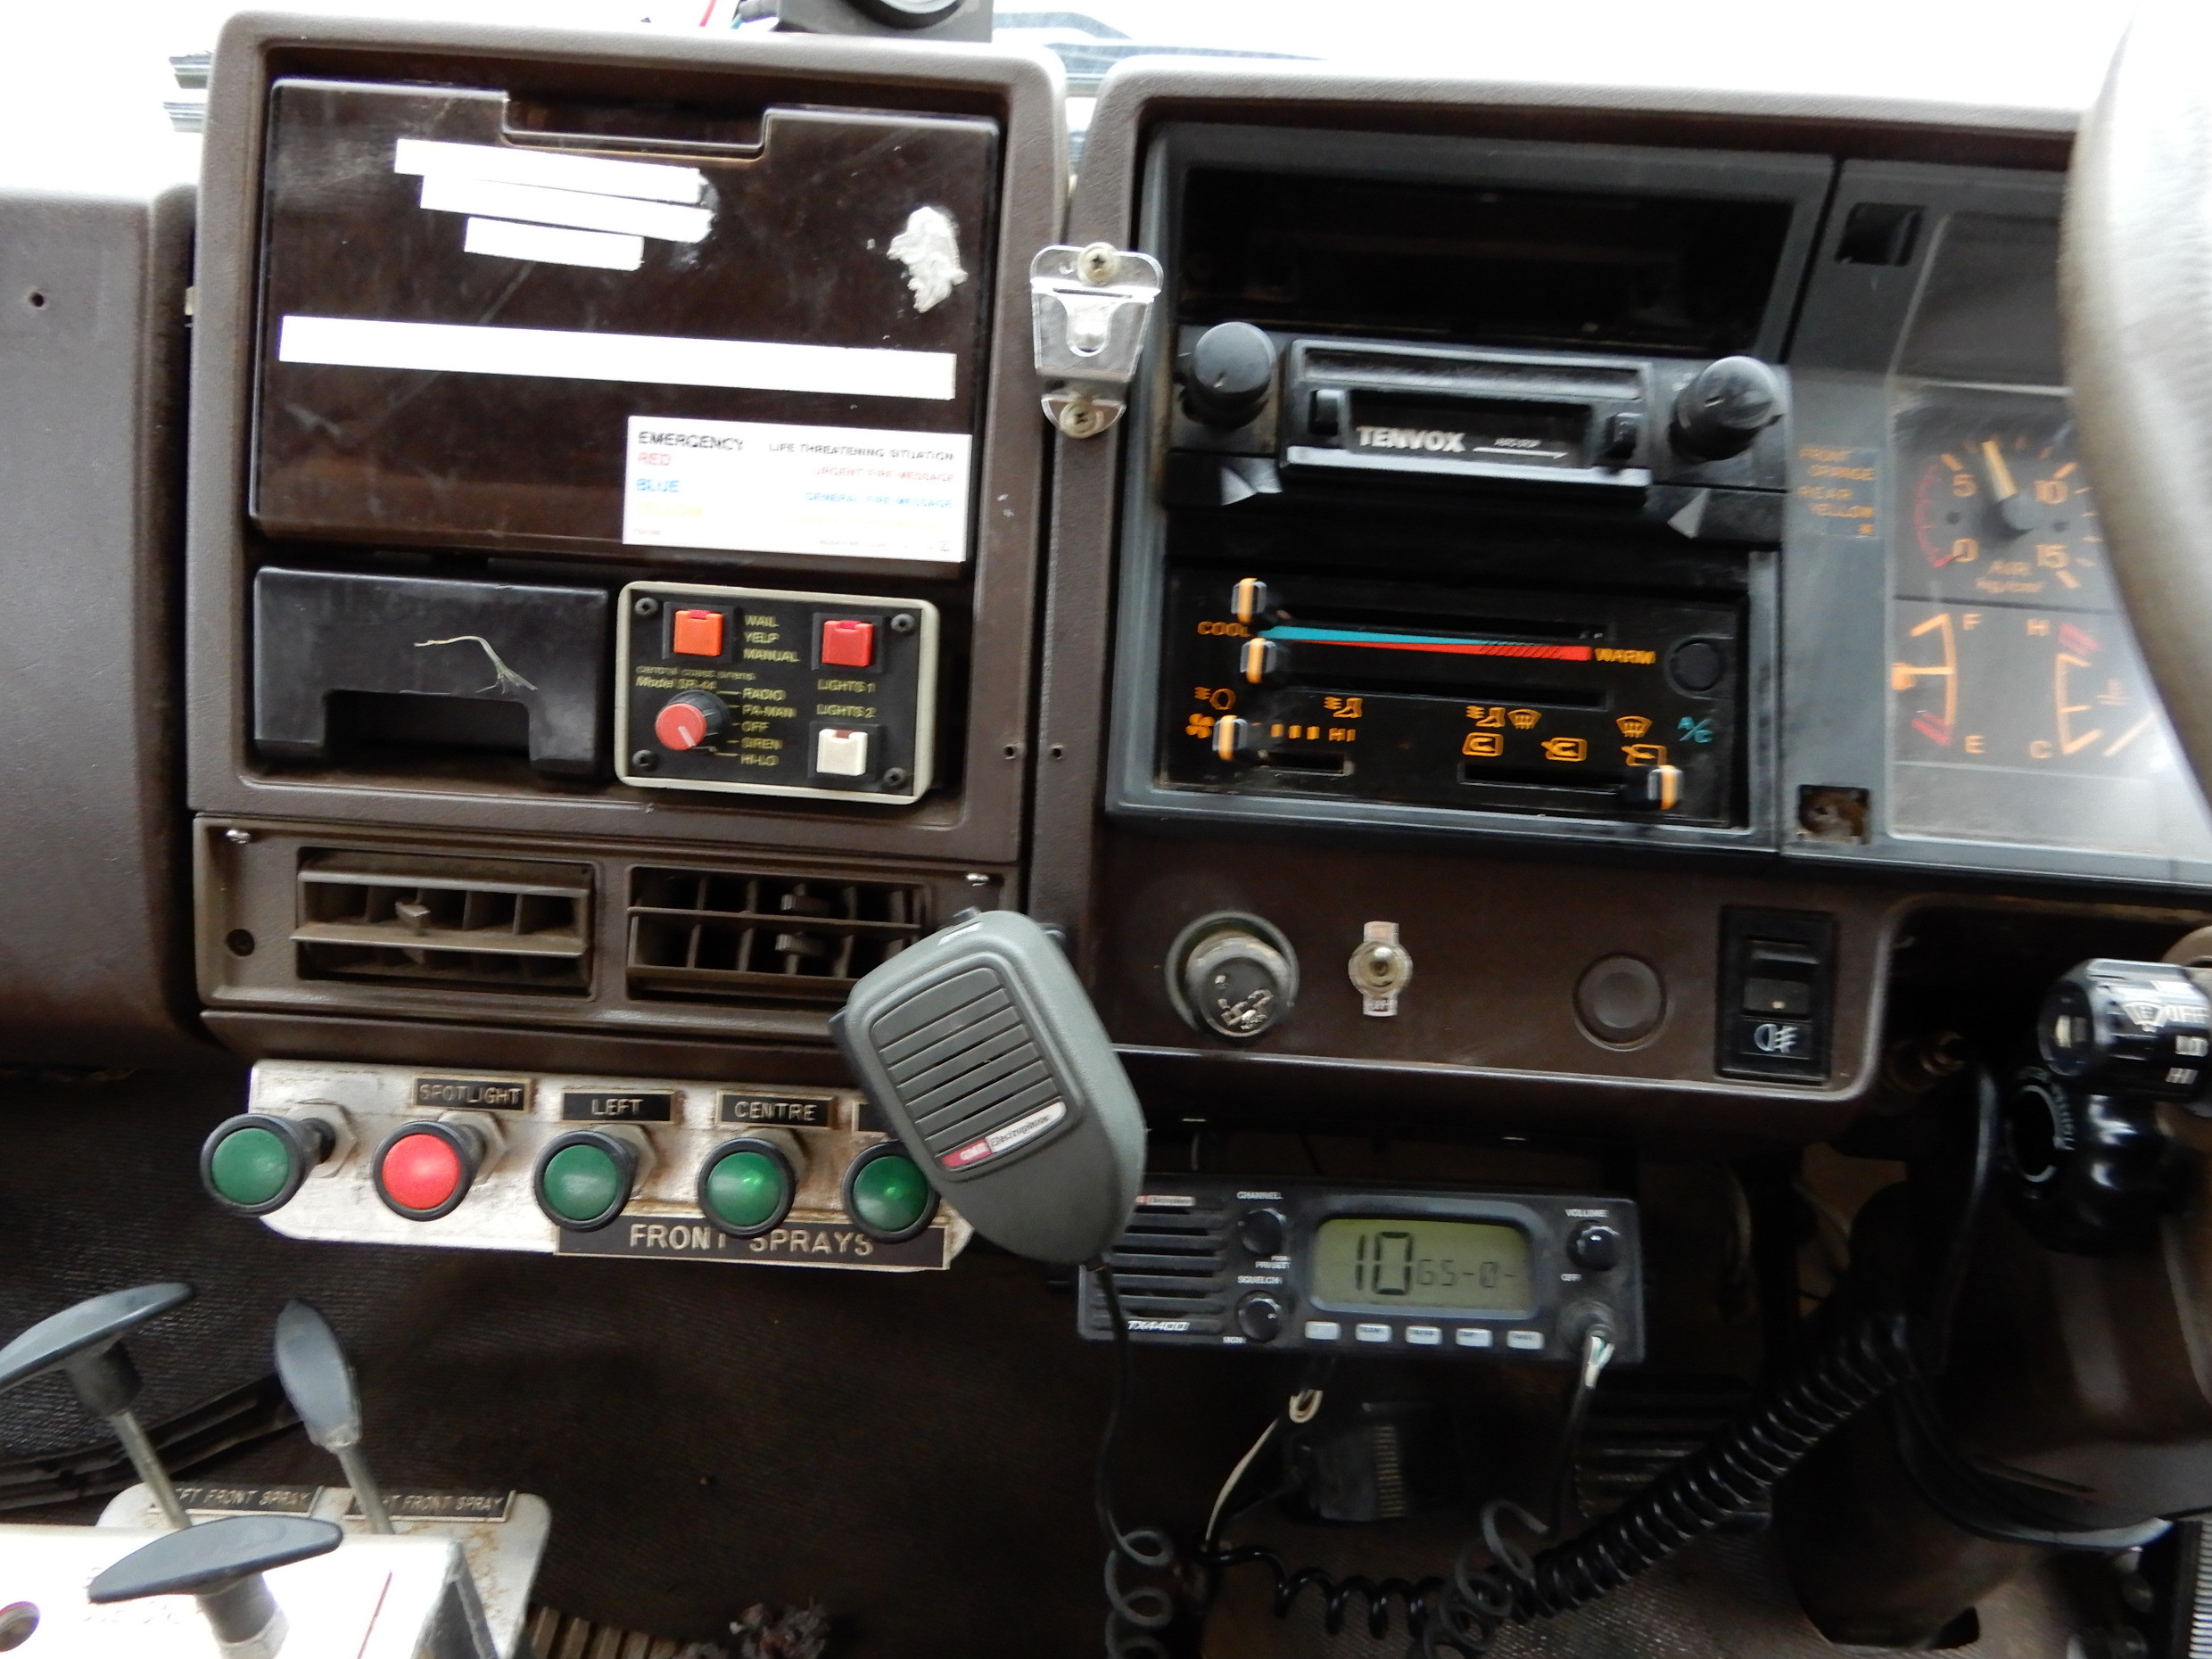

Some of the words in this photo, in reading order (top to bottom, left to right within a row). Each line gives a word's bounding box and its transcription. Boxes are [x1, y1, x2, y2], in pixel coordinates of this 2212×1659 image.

[638, 431, 744, 451] EMERGENCY
[1356, 425, 1465, 453] TENVOX
[637, 452, 671, 466] RED
[770, 442, 796, 453] LIFE
[799, 443, 885, 458] THREATENING
[890, 448, 955, 461] SITUATION
[897, 471, 954, 483] MESSAGE
[1952, 473, 1977, 497] 5
[636, 478, 681, 493] BLUE
[1797, 485, 1853, 501] REAR
[2033, 481, 2068, 505] 10
[805, 491, 860, 504] GENERAL
[896, 497, 953, 508] MESSAGE
[1810, 503, 1875, 519] YELLOW
[1953, 539, 1979, 562] 0
[2035, 544, 2068, 568] 15
[745, 615, 780, 628] WAIL
[1197, 621, 1251, 637] COOL
[1963, 614, 1981, 631] F
[2026, 619, 2050, 636] H
[745, 631, 780, 645] YELP
[743, 648, 801, 664] MANUAL
[1594, 648, 1656, 664] WARM
[817, 679, 865, 693] LIGHTS
[868, 682, 876, 693] 1
[743, 688, 787, 702] RADIO
[742, 705, 797, 718] PA-MAN
[817, 703, 864, 718] LIGHTS
[865, 708, 877, 718] 2
[741, 721, 770, 733] OFF
[1328, 727, 1357, 742] HI
[1677, 716, 1713, 744] A/C
[741, 737, 783, 750] SIREN
[1965, 735, 1985, 755] E
[2029, 740, 2053, 760] C
[740, 754, 780, 767] HI-LO
[419, 1083, 523, 1106] SPOTLIGHT
[590, 1098, 644, 1117] LEFT
[733, 1100, 817, 1122] CENTRE
[1565, 1209, 1610, 1218] VOLUME
[749, 1229, 874, 1257] SPRAYS
[1354, 1231, 1413, 1296] 10
[1127, 1320, 1190, 1333] TX4400
[203, 1489, 259, 1505] FRONT
[259, 1490, 310, 1506] SPRAY
[400, 1495, 455, 1511] FRONT
[456, 1496, 505, 1512] SPRAY
